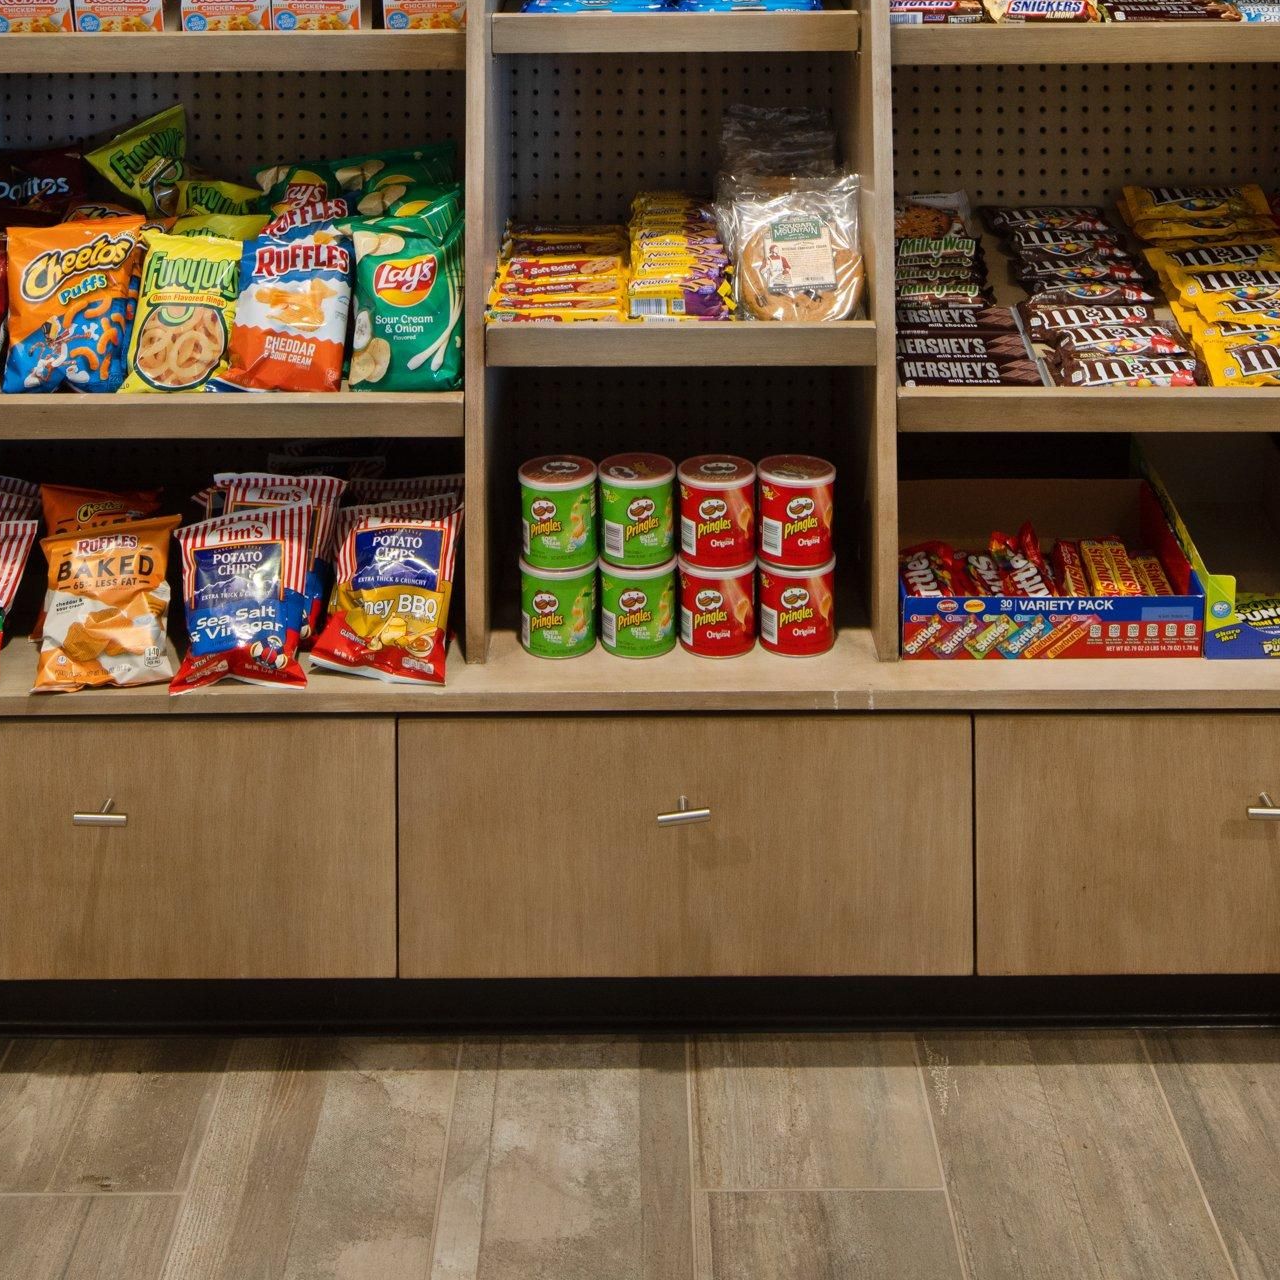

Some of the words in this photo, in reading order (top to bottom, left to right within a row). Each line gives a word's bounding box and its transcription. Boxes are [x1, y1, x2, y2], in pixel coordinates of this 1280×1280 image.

[1012, 1, 1083, 13] SNICKERS
[23, 233, 135, 300] Cheetos
[251, 243, 351, 278] RUFFLES
[377, 256, 436, 293] Lay's
[530, 265, 550, 276] Soft
[58, 273, 108, 307] Puffs
[153, 293, 173, 302] Onion
[174, 293, 205, 304] Flavored
[205, 294, 226, 308] Rings
[376, 315, 398, 325] Sour
[400, 315, 433, 324] Cream
[394, 323, 424, 333] Onion
[265, 336, 316, 356] CHEDDAR
[896, 337, 987, 355] HERSHEY'S
[270, 351, 287, 363] SOUR
[288, 354, 312, 366] CREAM
[904, 361, 1000, 379] HERSHEY'S
[258, 485, 303, 503] Tim's
[217, 525, 264, 542] Tim's
[530, 520, 562, 540] Pringles
[625, 515, 660, 541] Pringles
[697, 516, 733, 537] Pringles
[783, 516, 819, 540] Pringles
[77, 535, 138, 558] RUFFLES
[372, 535, 423, 549] POTATO
[710, 537, 735, 548] Original
[212, 551, 263, 566] POTATO
[375, 546, 416, 561] CHIPS
[57, 554, 154, 582] BAKED
[217, 563, 257, 576] CHIPS
[95, 579, 118, 588] LESS
[121, 577, 137, 586] FAT
[376, 575, 395, 583] THICK
[397, 594, 438, 622] BBQ
[1019, 600, 1075, 611] VARIETY
[1078, 600, 1114, 611] PACK
[196, 614, 232, 629] Sea
[235, 606, 276, 618] Salt
[531, 613, 564, 632] Pringles
[617, 610, 652, 631] Pringles
[694, 609, 729, 630] Pringles
[905, 622, 942, 655] Skittles
[941, 622, 978, 655] Skittles
[975, 621, 1010, 654] Skittles
[1008, 622, 1045, 655] Skittles
